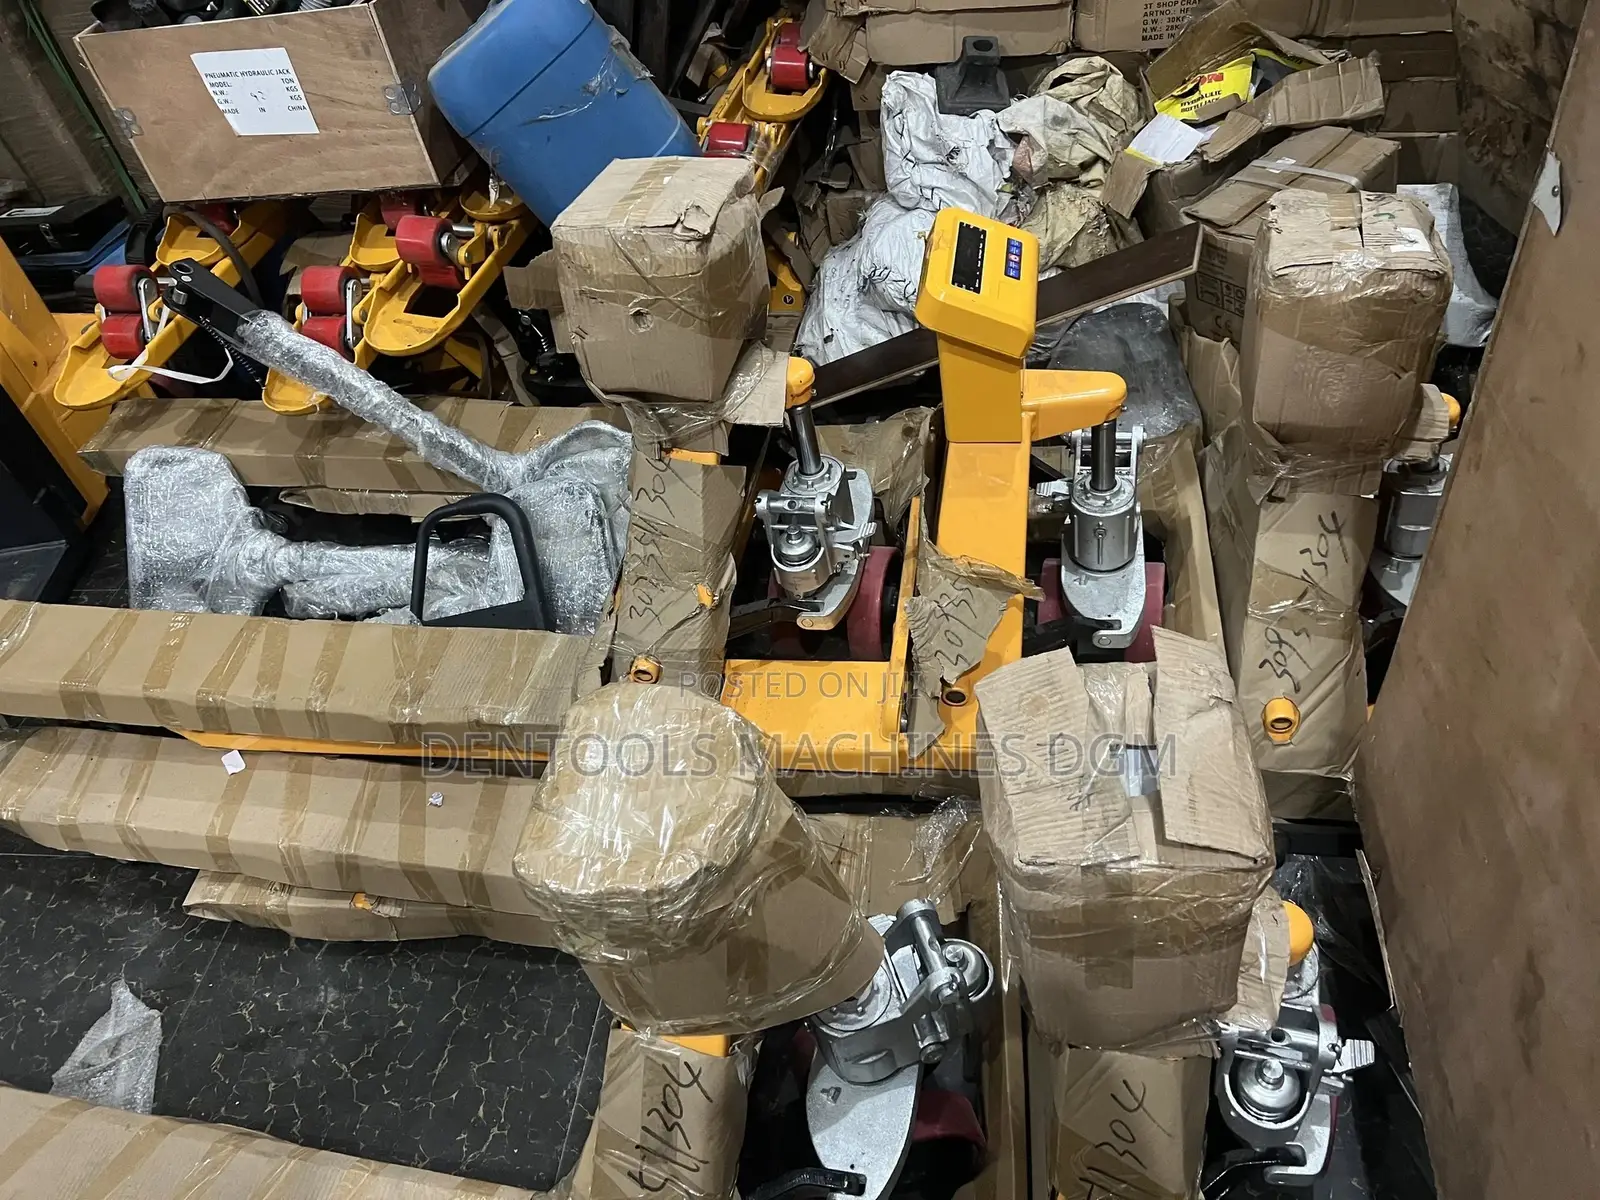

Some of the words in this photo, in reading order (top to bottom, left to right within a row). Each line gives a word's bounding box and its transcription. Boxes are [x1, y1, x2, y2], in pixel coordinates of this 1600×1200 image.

[1141, 33, 1164, 41] MADE
[204, 71, 240, 79] PNEUMATIC
[240, 69, 275, 77] HYDRAULIC
